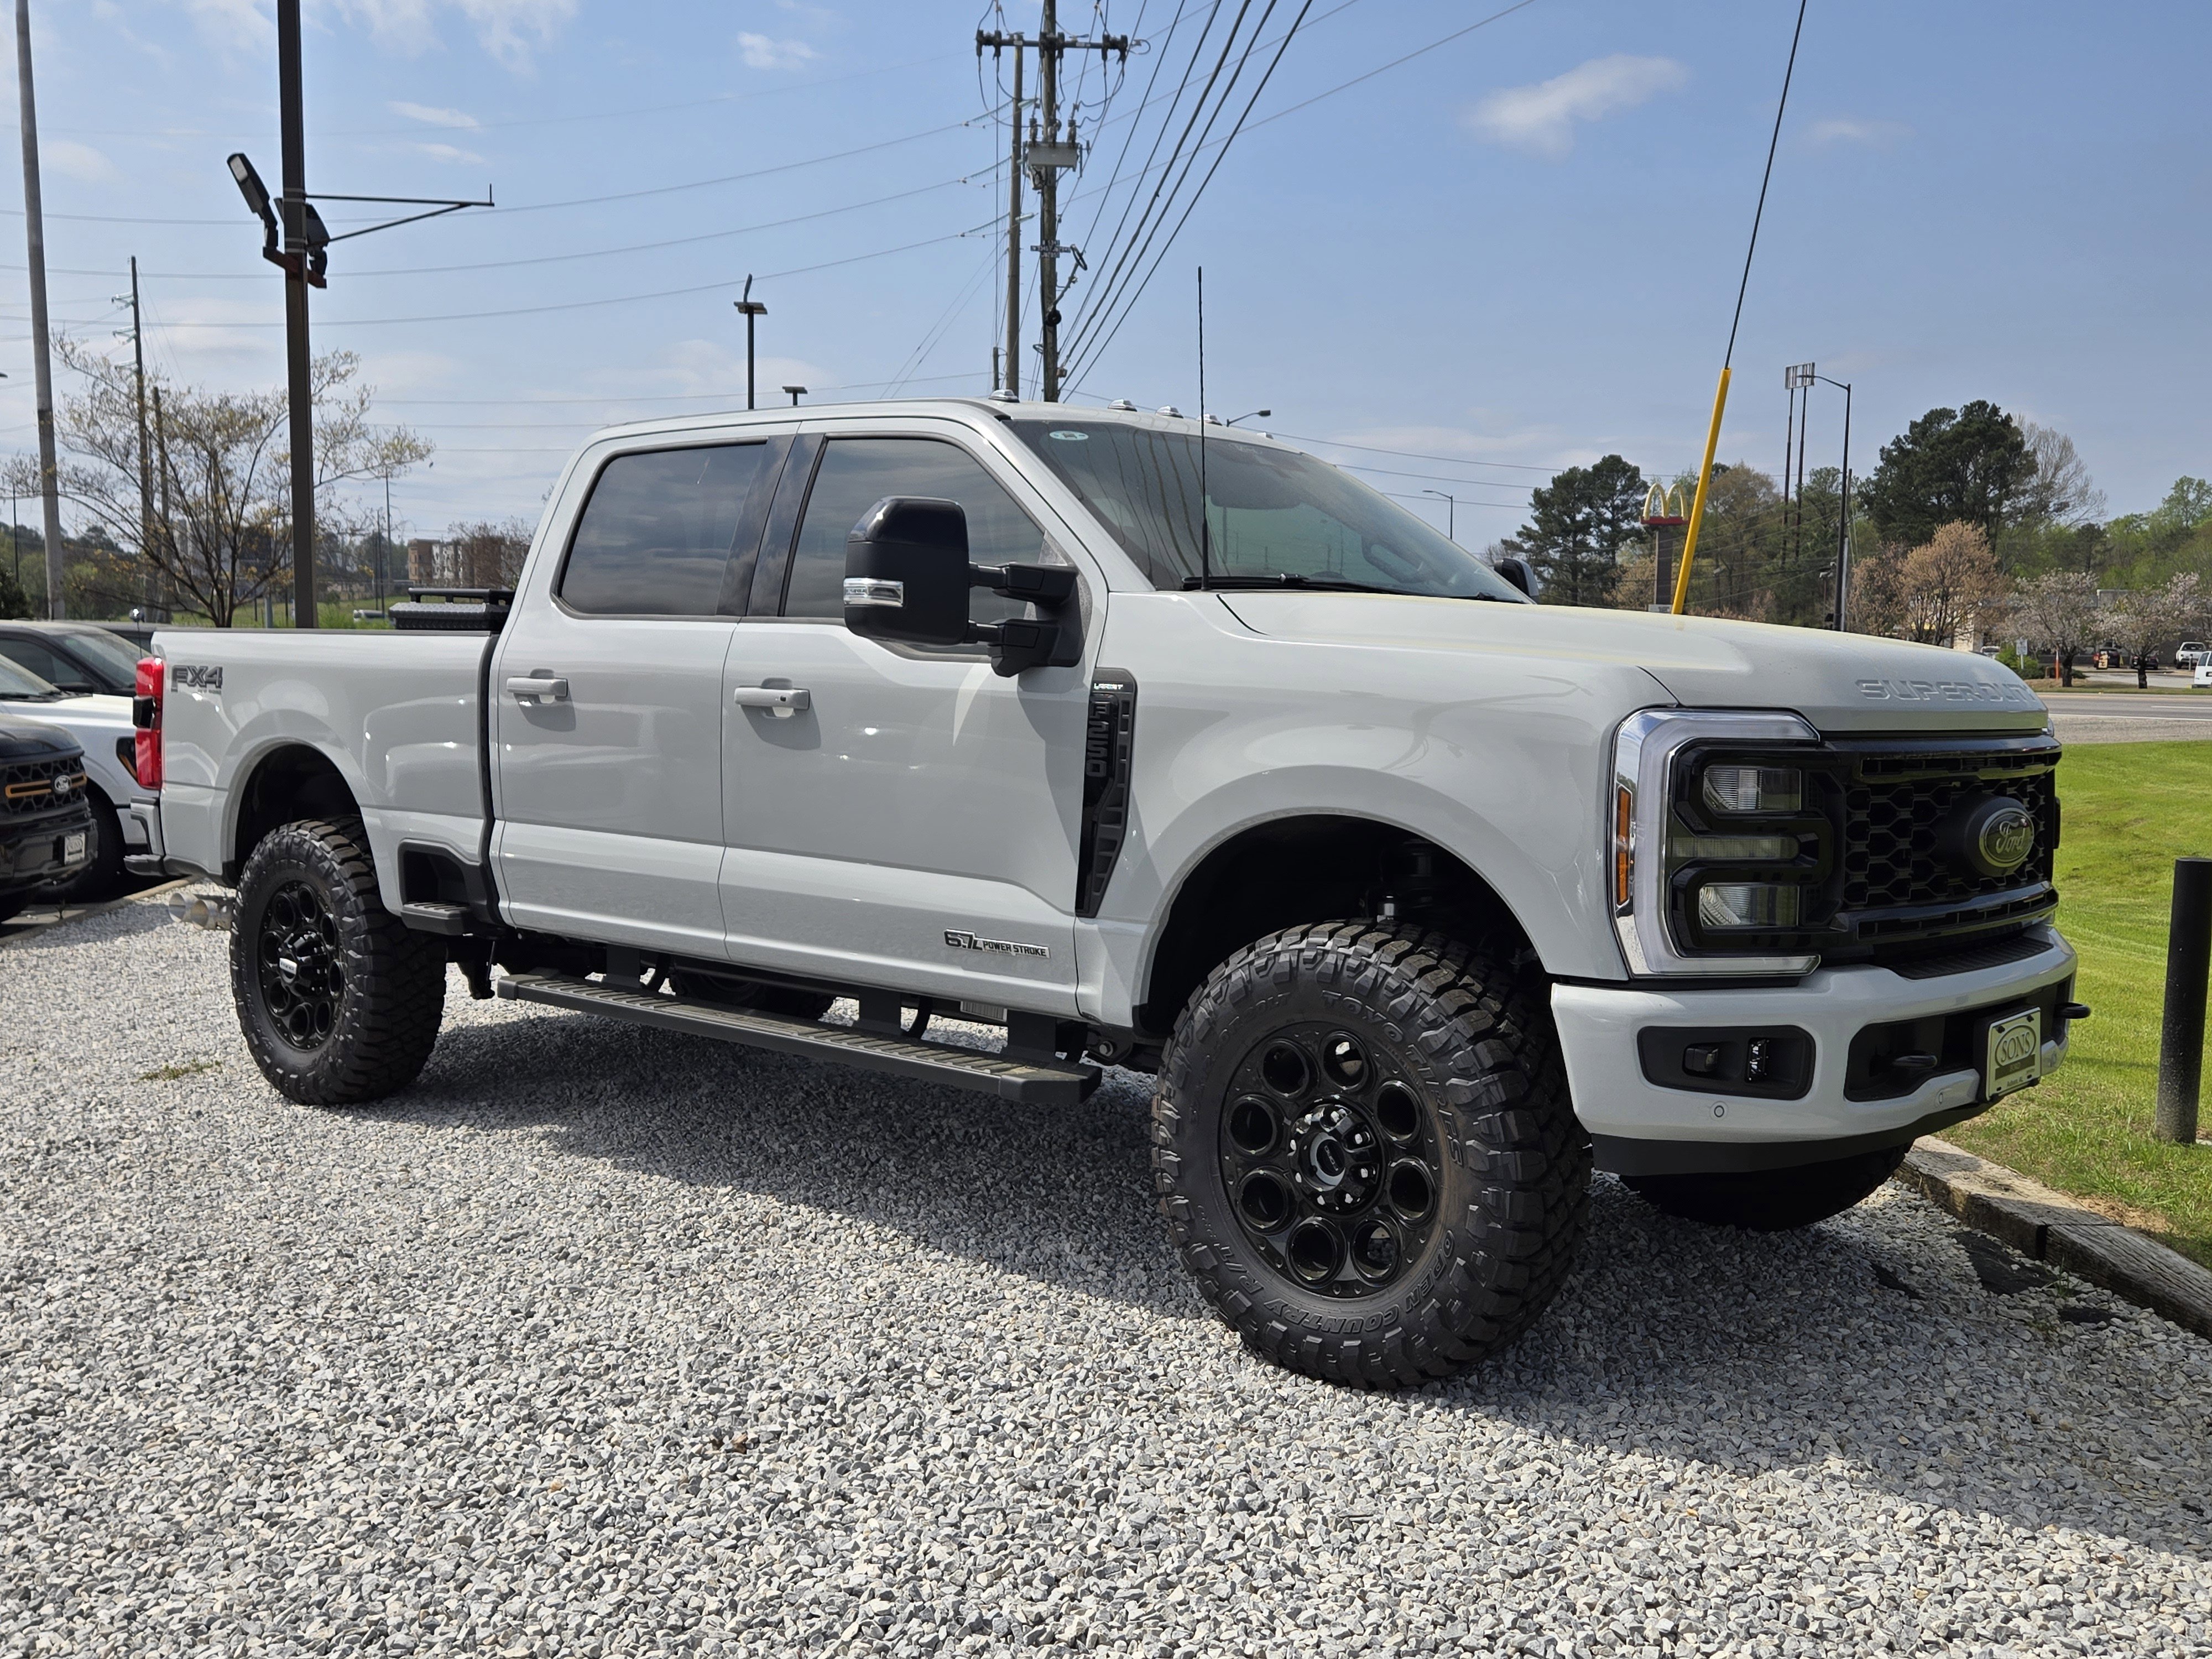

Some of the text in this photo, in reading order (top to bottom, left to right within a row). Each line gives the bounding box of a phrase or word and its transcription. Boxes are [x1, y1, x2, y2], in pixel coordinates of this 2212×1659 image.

[171, 665, 223, 692] FX4
[1995, 820, 2026, 854] Ford
[944, 929, 983, 951] 6.7L
[983, 941, 1011, 952] POWER
[1014, 945, 1046, 956] STROKE
[2000, 1031, 2031, 1063] SONS
[1321, 989, 1404, 1043] TOYO
[1406, 1044, 1464, 1168] TIRES
[1213, 1242, 1264, 1295] R/T
[1405, 1229, 1455, 1314] OPEN
[1264, 1298, 1401, 1334] COUNTRY
